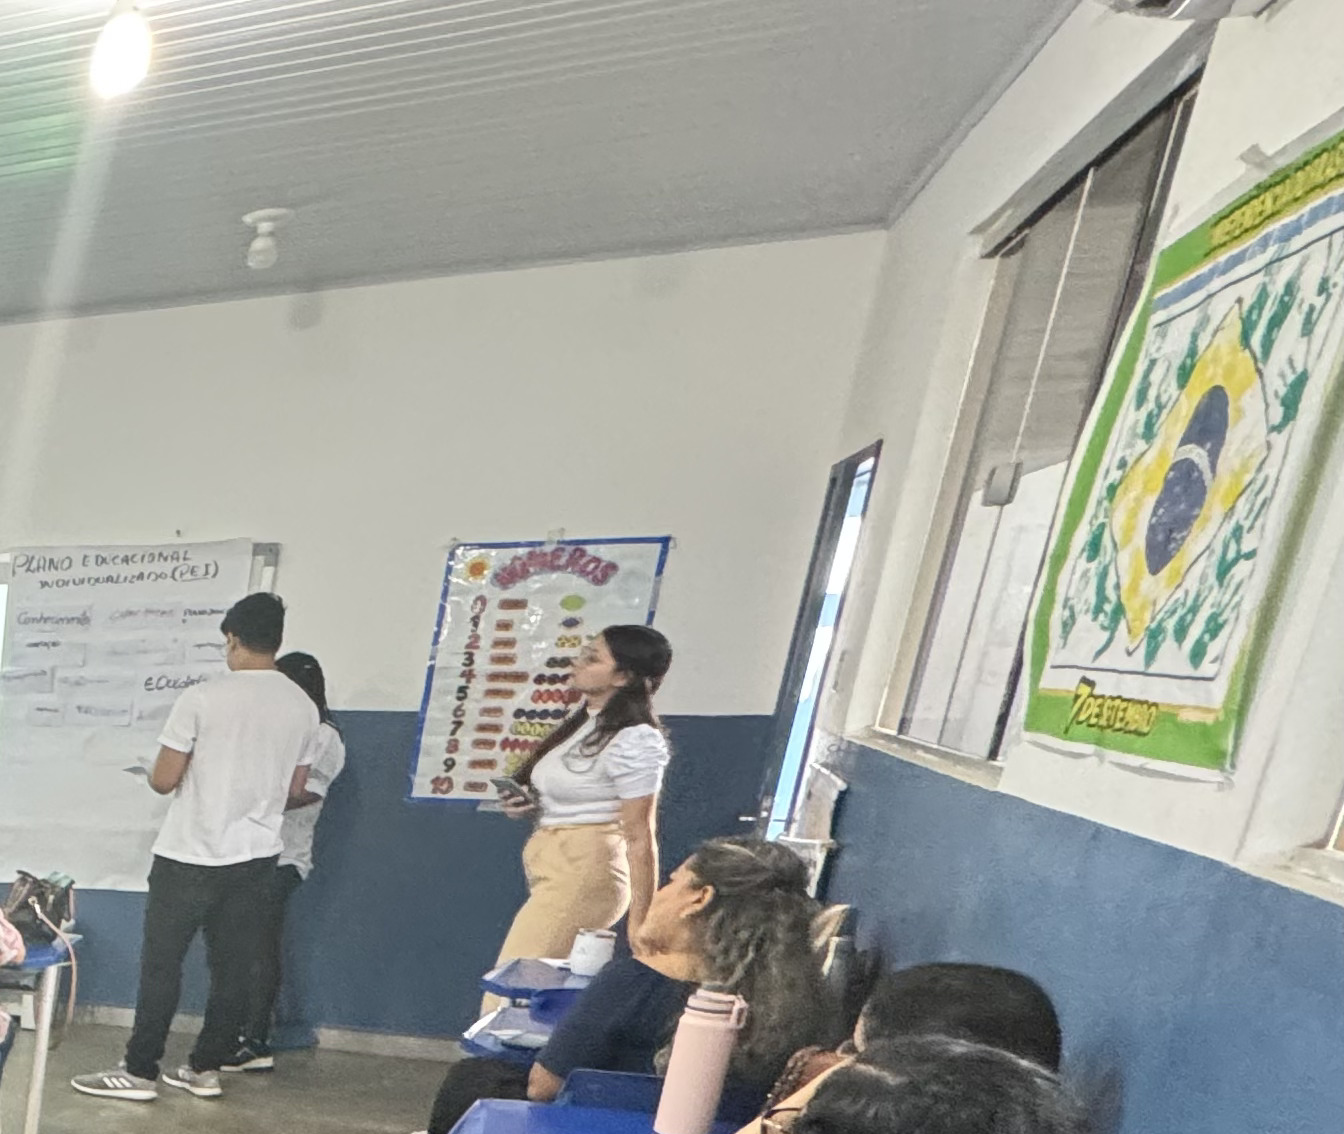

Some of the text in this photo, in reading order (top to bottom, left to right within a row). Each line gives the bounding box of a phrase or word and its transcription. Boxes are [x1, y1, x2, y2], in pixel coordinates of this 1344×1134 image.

[13, 550, 193, 577] PLANO EDUCACIONAL
[465, 633, 481, 650] 2
[462, 651, 475, 667] 3
[459, 668, 476, 684] 4
[455, 685, 470, 701] 5
[453, 703, 466, 718] 6
[1063, 676, 1096, 734] 7
[449, 720, 464, 736] 7
[446, 738, 460, 754] 8
[443, 757, 456, 773] 9
[430, 776, 454, 794] 10
